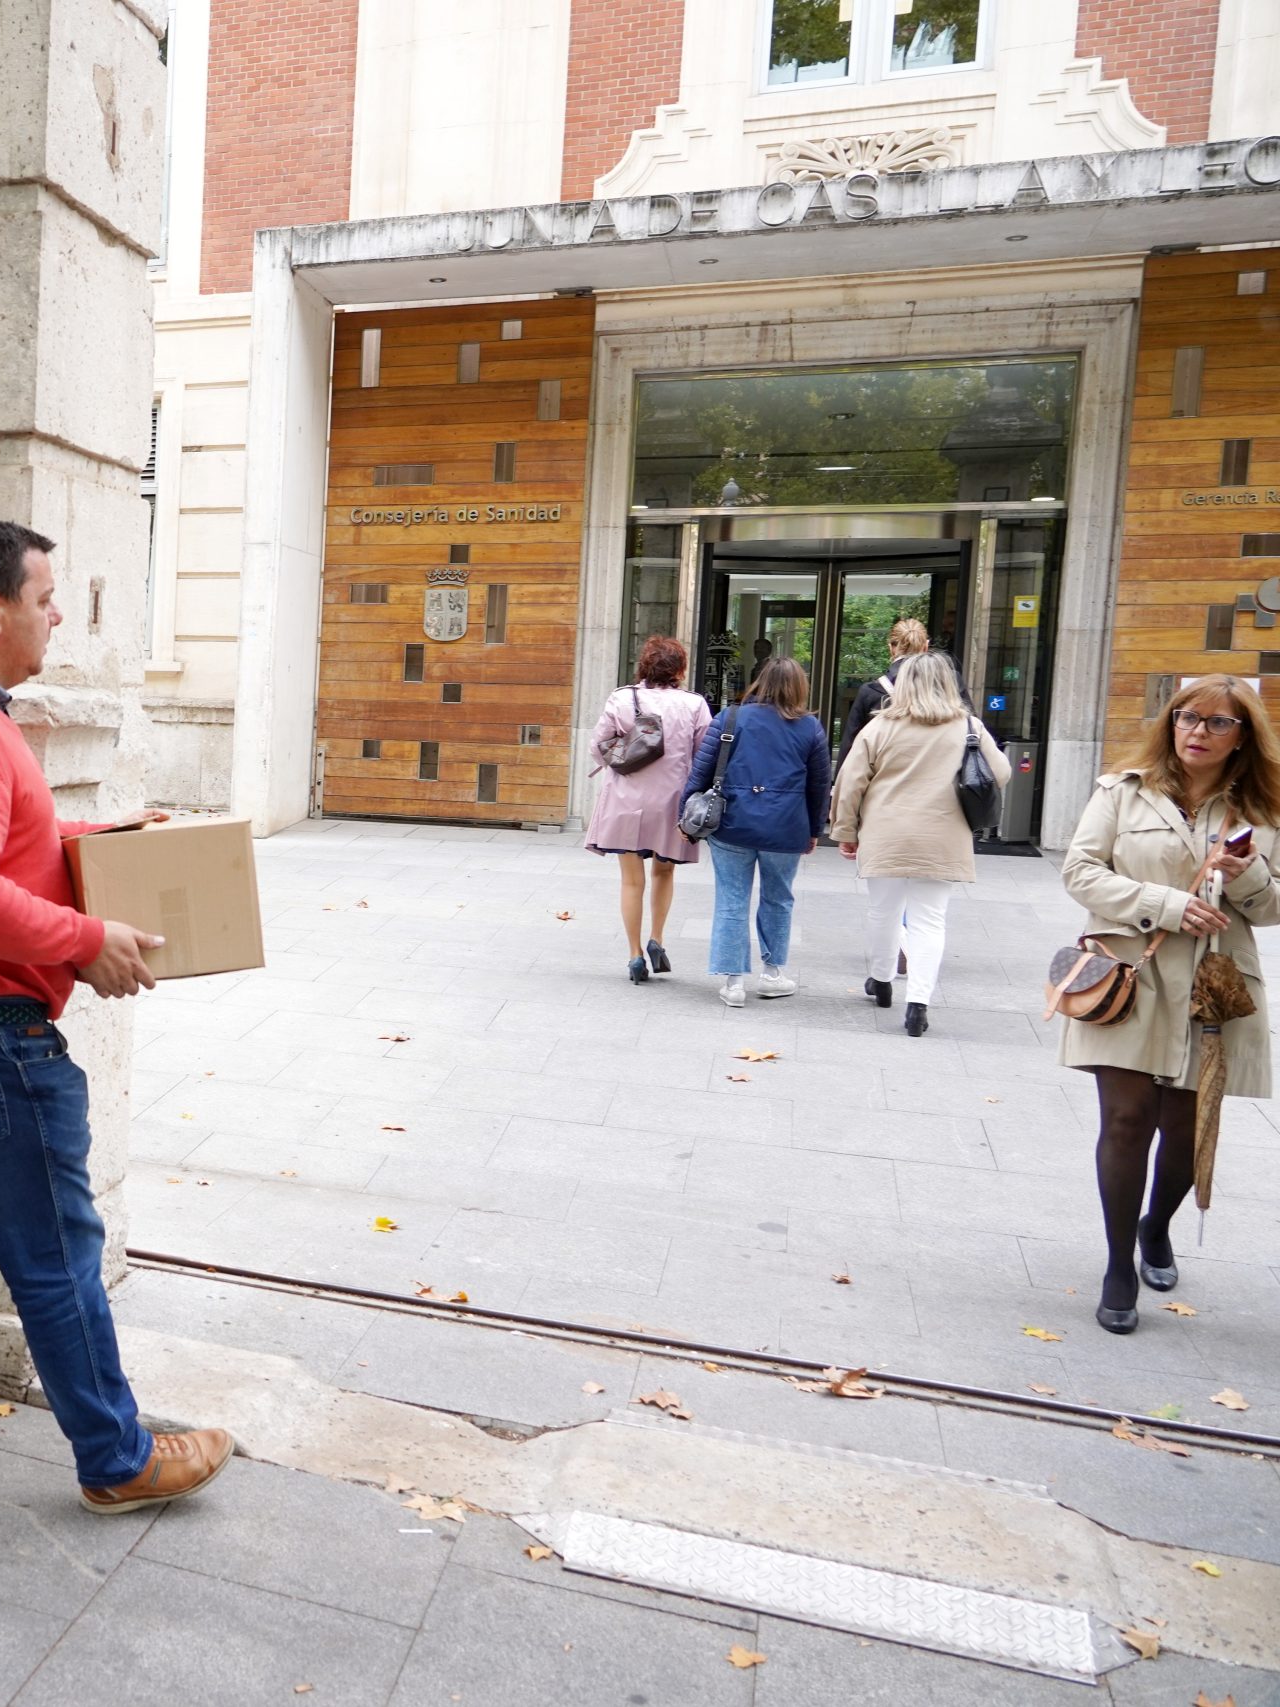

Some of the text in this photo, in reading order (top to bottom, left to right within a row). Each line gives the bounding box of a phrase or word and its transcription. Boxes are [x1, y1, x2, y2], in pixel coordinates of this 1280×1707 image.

[648, 190, 718, 238] DE
[757, 161, 1050, 227] CASTILLA
[1080, 151, 1121, 199] Y
[1183, 491, 1258, 505] Gerencia
[350, 504, 561, 527] Consejería de Sanidad
